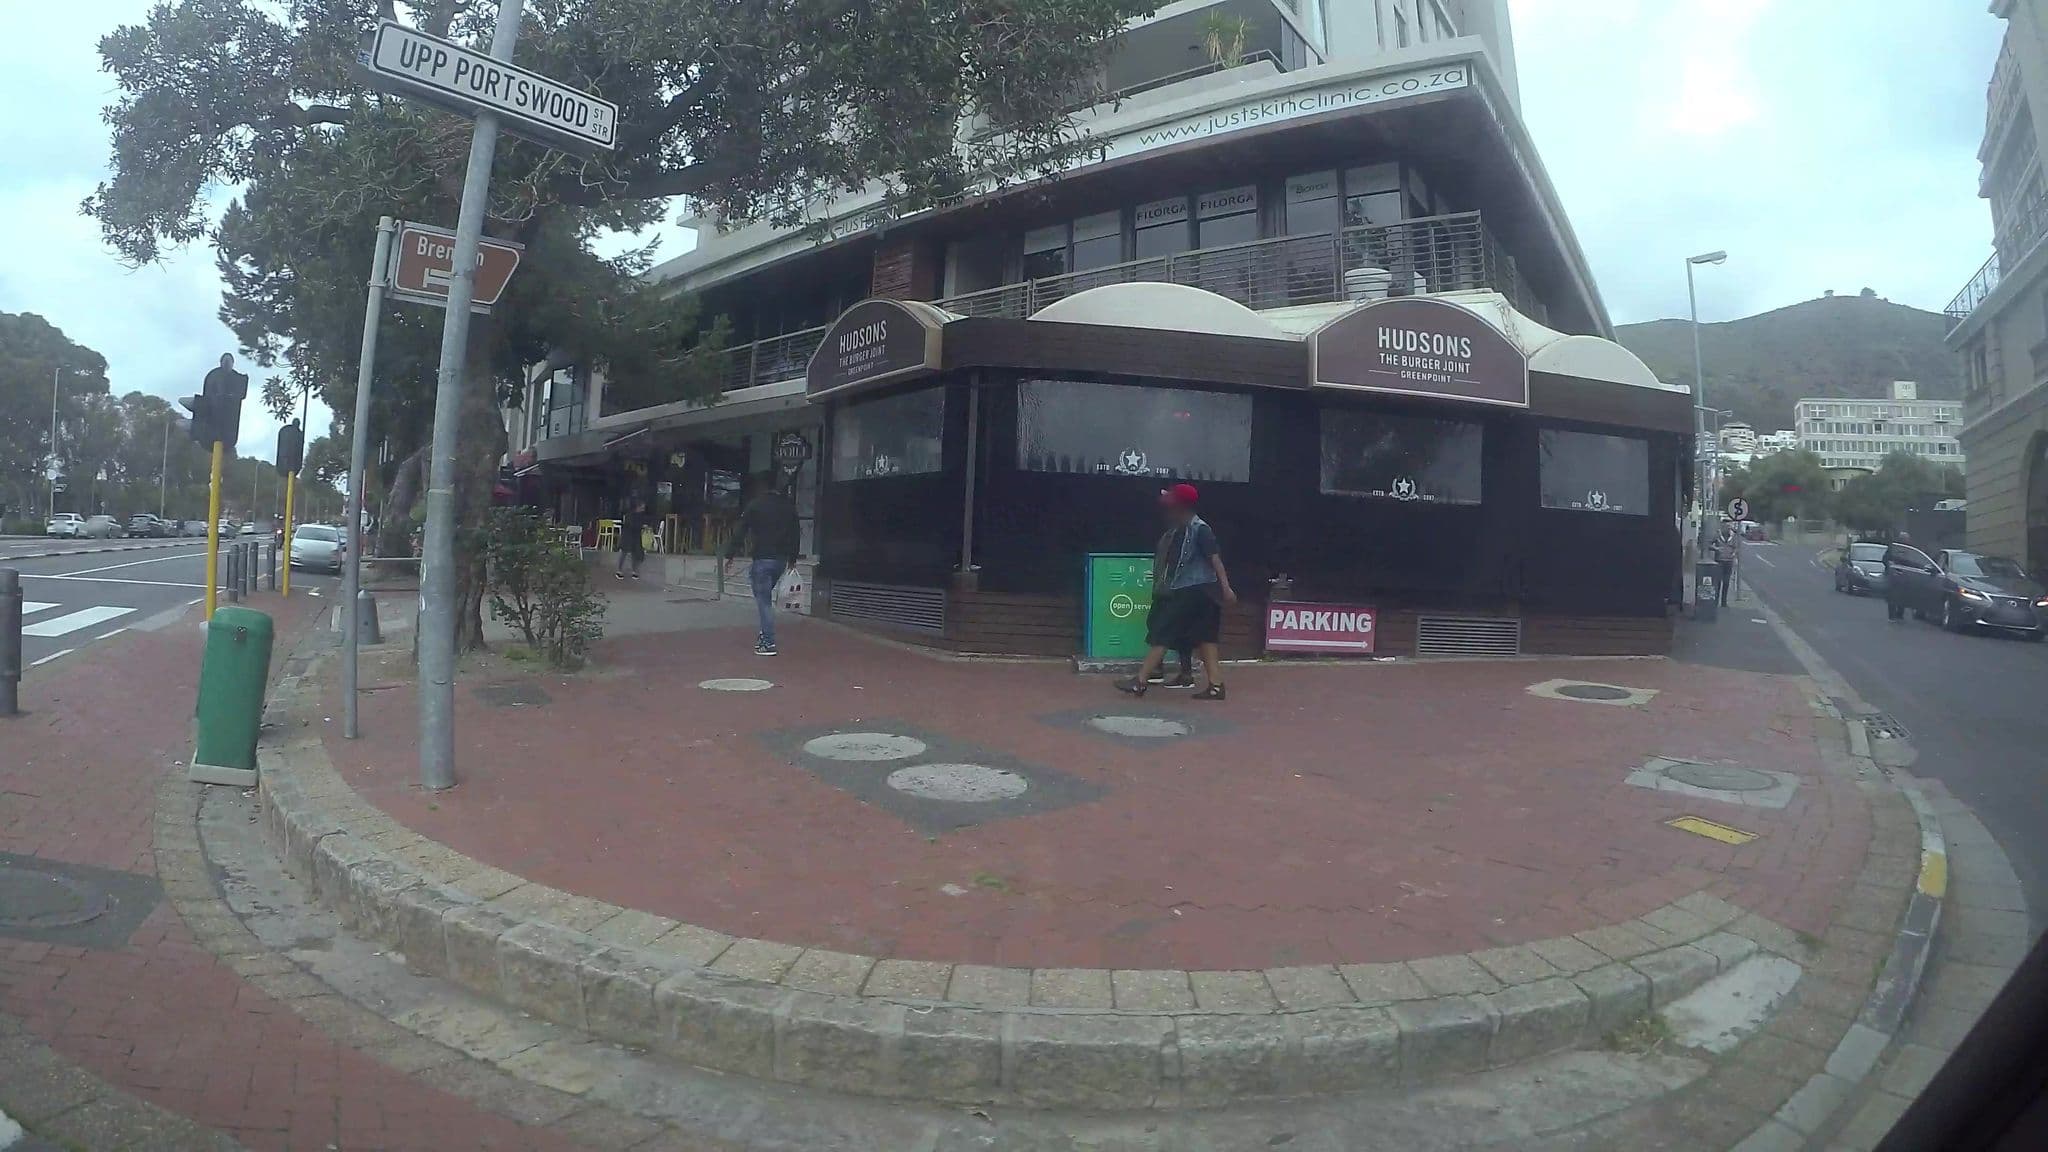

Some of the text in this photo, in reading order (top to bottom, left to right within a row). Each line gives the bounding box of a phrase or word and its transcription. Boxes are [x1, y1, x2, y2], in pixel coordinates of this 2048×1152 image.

[400, 38, 589, 128] UPP PORTSWOOD
[593, 107, 604, 121] ST
[1139, 67, 1464, 147] www.justskinclinic.co.za
[592, 122, 609, 138] STR
[1136, 203, 1188, 222] FILORGA
[1199, 193, 1254, 211] FILORGA
[416, 236, 485, 266] Brenn
[839, 320, 887, 354] HUDSONS
[1378, 326, 1472, 358] HUDSONS
[1379, 352, 1471, 374] THE BURGER JOINT
[1400, 370, 1452, 383] GREENPOINT
[1112, 602, 1131, 611] open
[1269, 608, 1373, 633] PARKING
